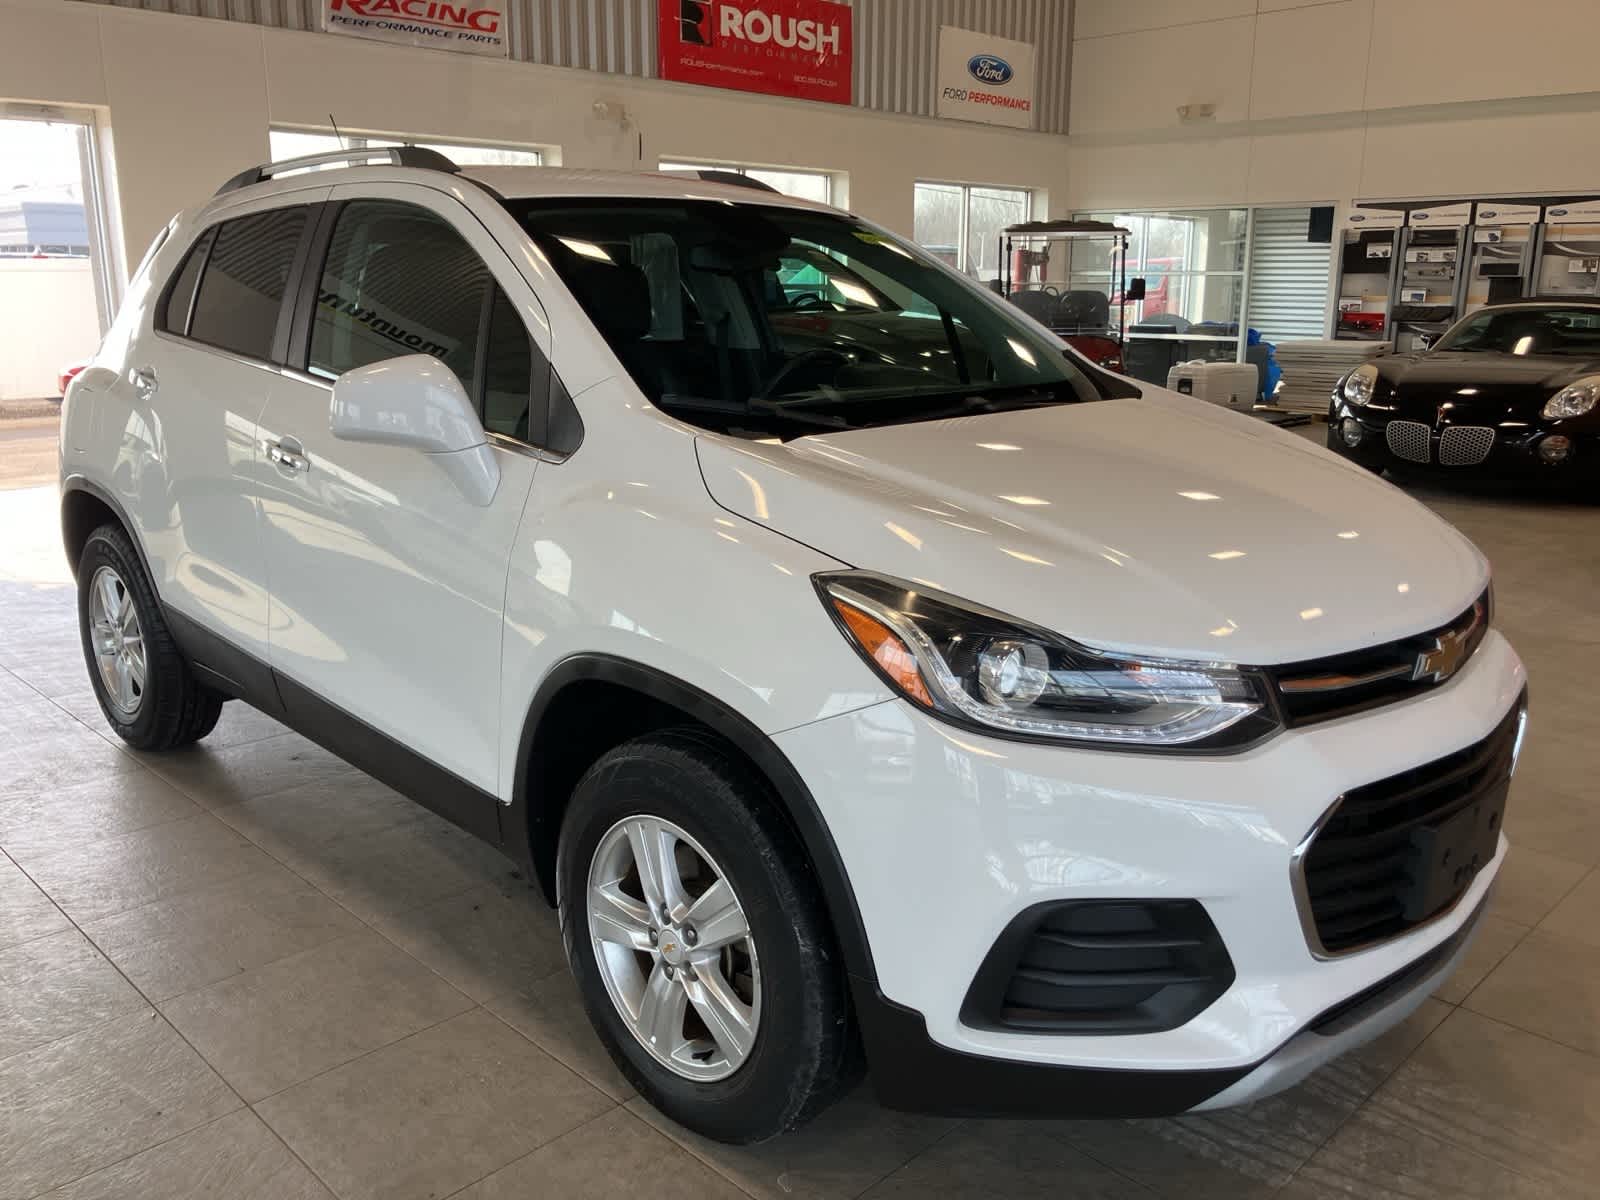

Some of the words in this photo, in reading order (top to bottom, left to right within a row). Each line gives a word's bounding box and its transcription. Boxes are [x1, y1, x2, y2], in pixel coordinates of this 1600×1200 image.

[330, 0, 500, 33] RACING
[330, 15, 453, 39] PERFORMANCE
[458, 33, 501, 45] PARTS
[720, 5, 840, 56] ROUSH
[943, 88, 967, 101] FORD
[968, 91, 1031, 112] PERFORMANCE
